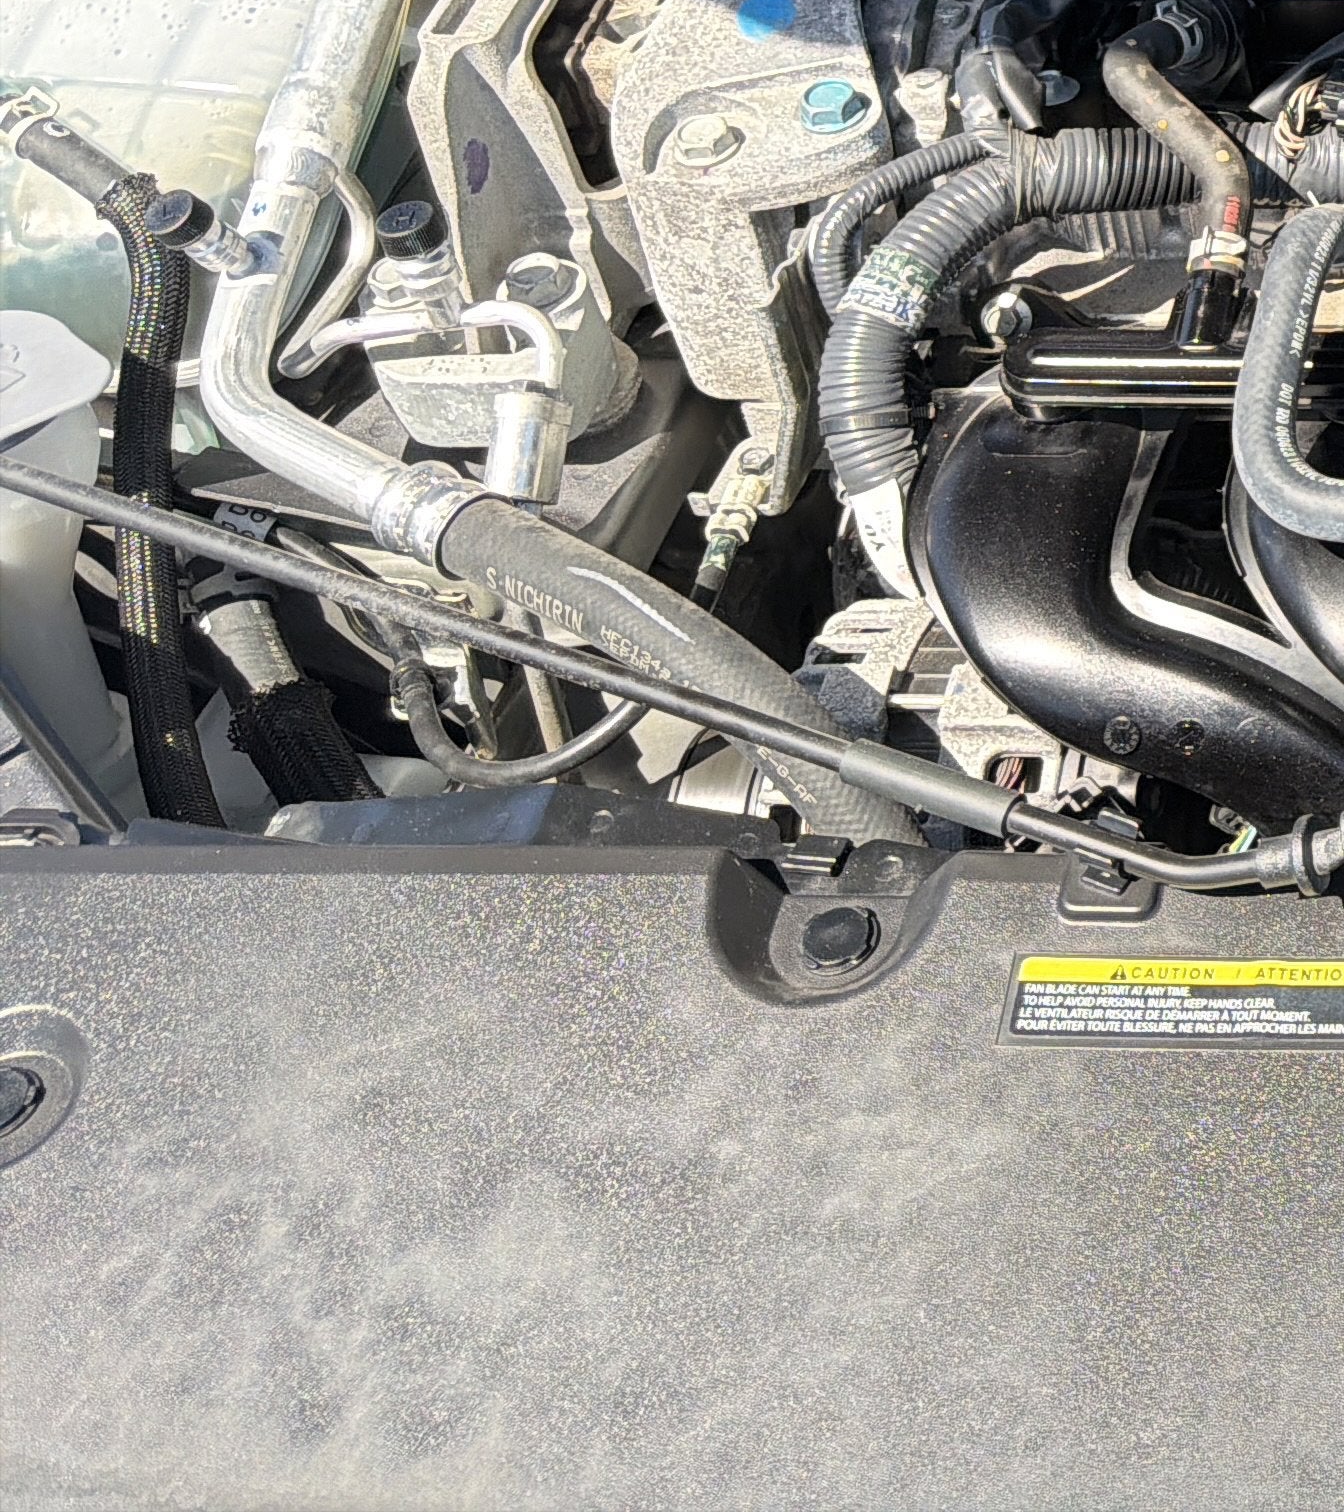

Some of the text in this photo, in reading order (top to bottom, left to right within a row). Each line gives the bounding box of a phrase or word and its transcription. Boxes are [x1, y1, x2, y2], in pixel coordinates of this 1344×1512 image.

[1131, 967, 1215, 980] CAUTION
[1024, 984, 1045, 994] FAN
[1045, 984, 1078, 995] BLADE
[1078, 985, 1100, 995] CAN
[1101, 985, 1131, 996] START
[1131, 986, 1145, 996] AT
[1022, 996, 1035, 1006] TO
[1037, 996, 1064, 1006] HELP
[1064, 996, 1095, 1007] AVOID
[1095, 997, 1145, 1008] PERSONAL
[1183, 998, 1208, 1009] KEEP
[1208, 998, 1243, 1009] HANDS
[1019, 1007, 1033, 1018] LE
[1034, 1008, 1105, 1020] VENTILATEUR
[1105, 1009, 1144, 1021] RISQUE
[1145, 1009, 1161, 1020] DE
[1230, 1010, 1259, 1021] TOUT
[1016, 1019, 1048, 1031] POUR
[1086, 1021, 1121, 1032] TOUTE
[1178, 1022, 1194, 1033] NE
[1194, 1023, 1215, 1033] PAS
[1216, 1023, 1233, 1034] EN
[1233, 1022, 1297, 1034] APPROCHER
[1297, 1023, 1317, 1035] LES
